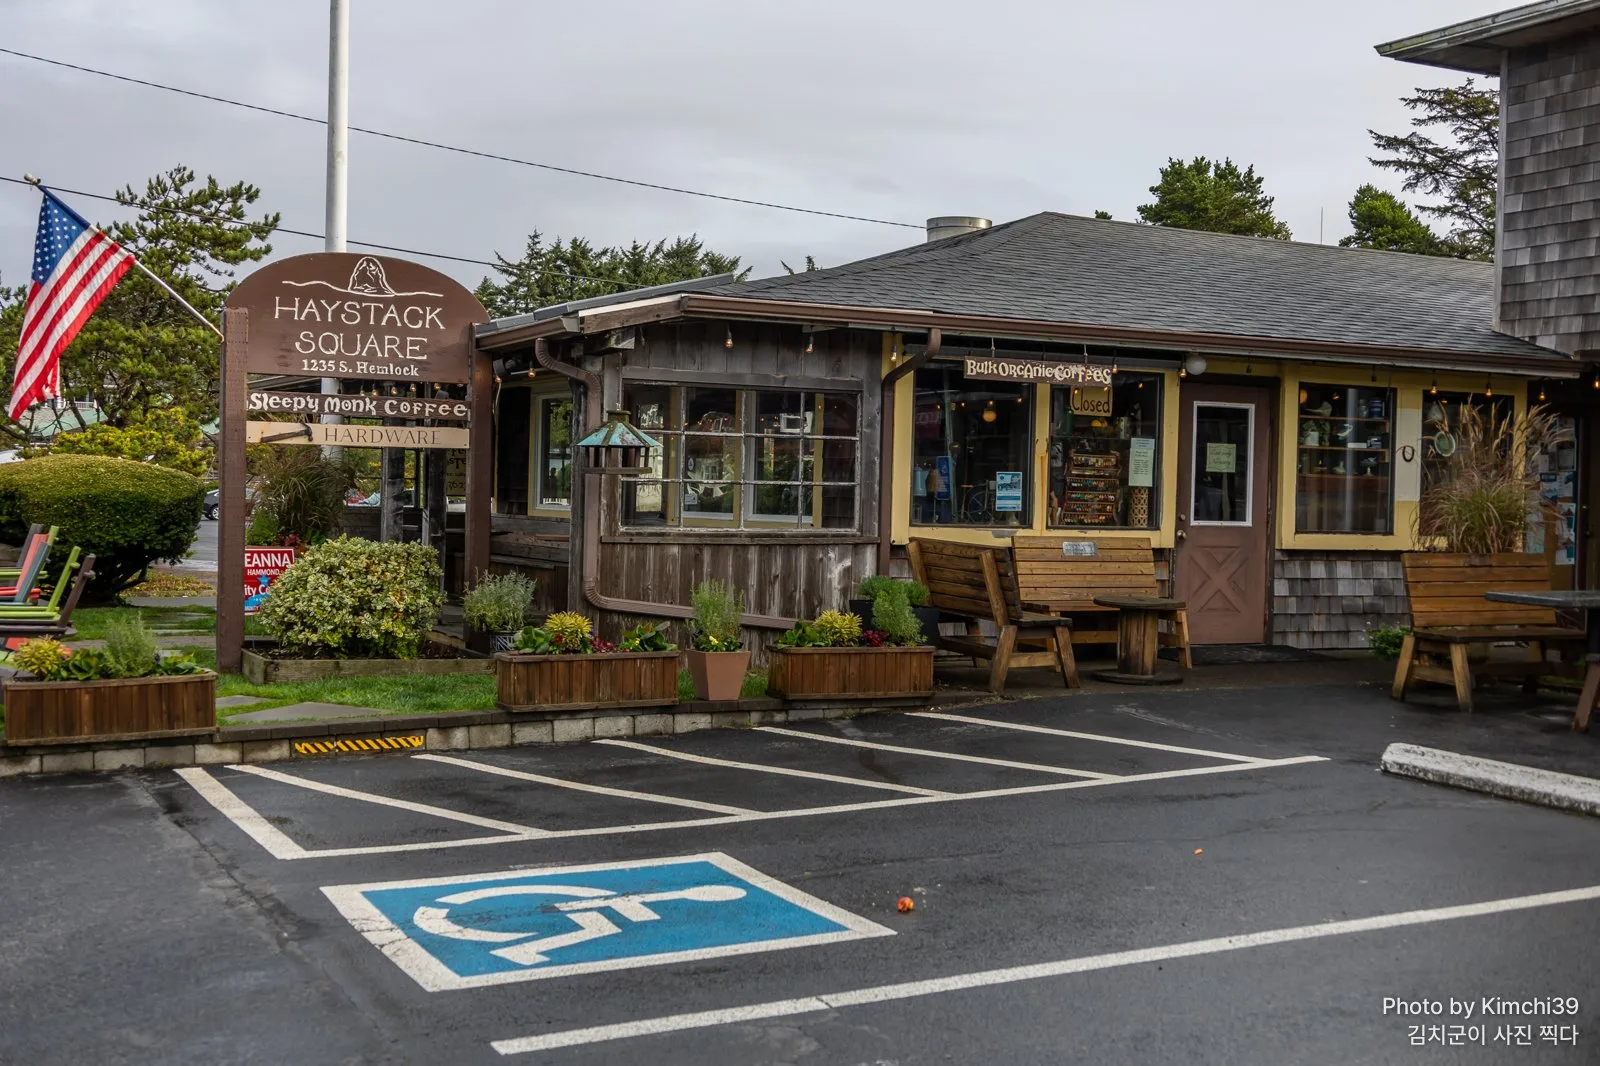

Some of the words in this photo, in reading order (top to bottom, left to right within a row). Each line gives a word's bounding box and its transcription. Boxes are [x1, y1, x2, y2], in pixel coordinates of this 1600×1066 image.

[274, 296, 446, 330] HAYSTACK
[294, 331, 428, 360] SQUARE
[301, 359, 336, 373] 1235
[339, 360, 353, 373] S.
[356, 360, 420, 377] Hemlock
[248, 392, 319, 413] Sleepy
[384, 398, 468, 418] Coffee
[1071, 386, 1110, 414] Closed
[324, 427, 442, 445] HARDWARE
